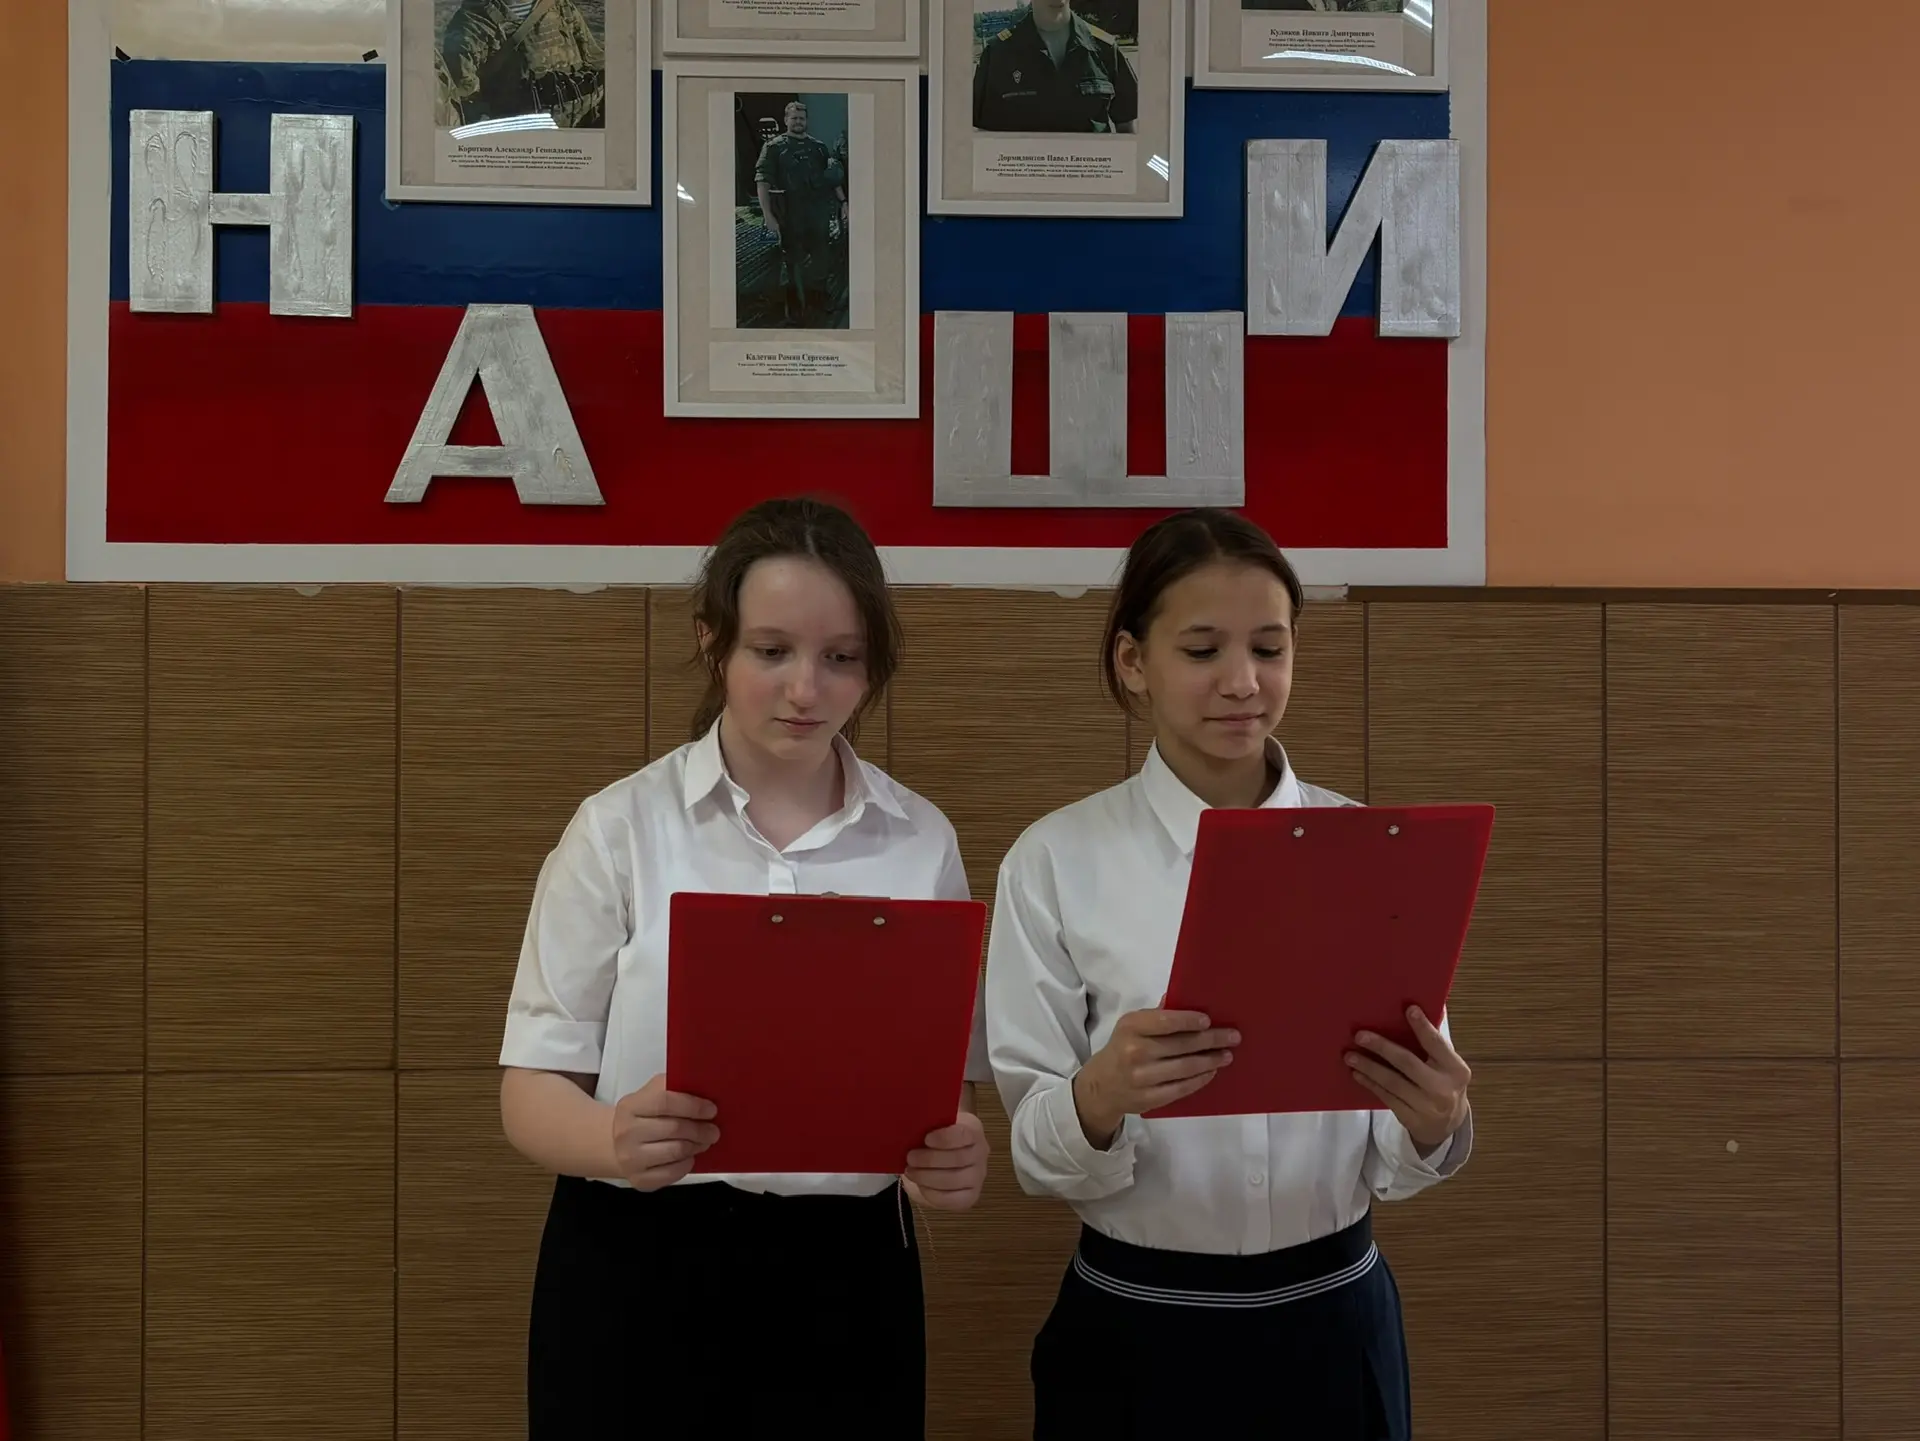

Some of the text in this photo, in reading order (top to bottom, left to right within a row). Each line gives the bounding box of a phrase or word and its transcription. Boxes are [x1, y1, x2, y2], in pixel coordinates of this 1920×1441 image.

[1330, 30, 1375, 38] Дмитриевич
[494, 146, 534, 154] Александр
[535, 146, 583, 154] Геннадьевич
[802, 354, 840, 362] Сергеевич
